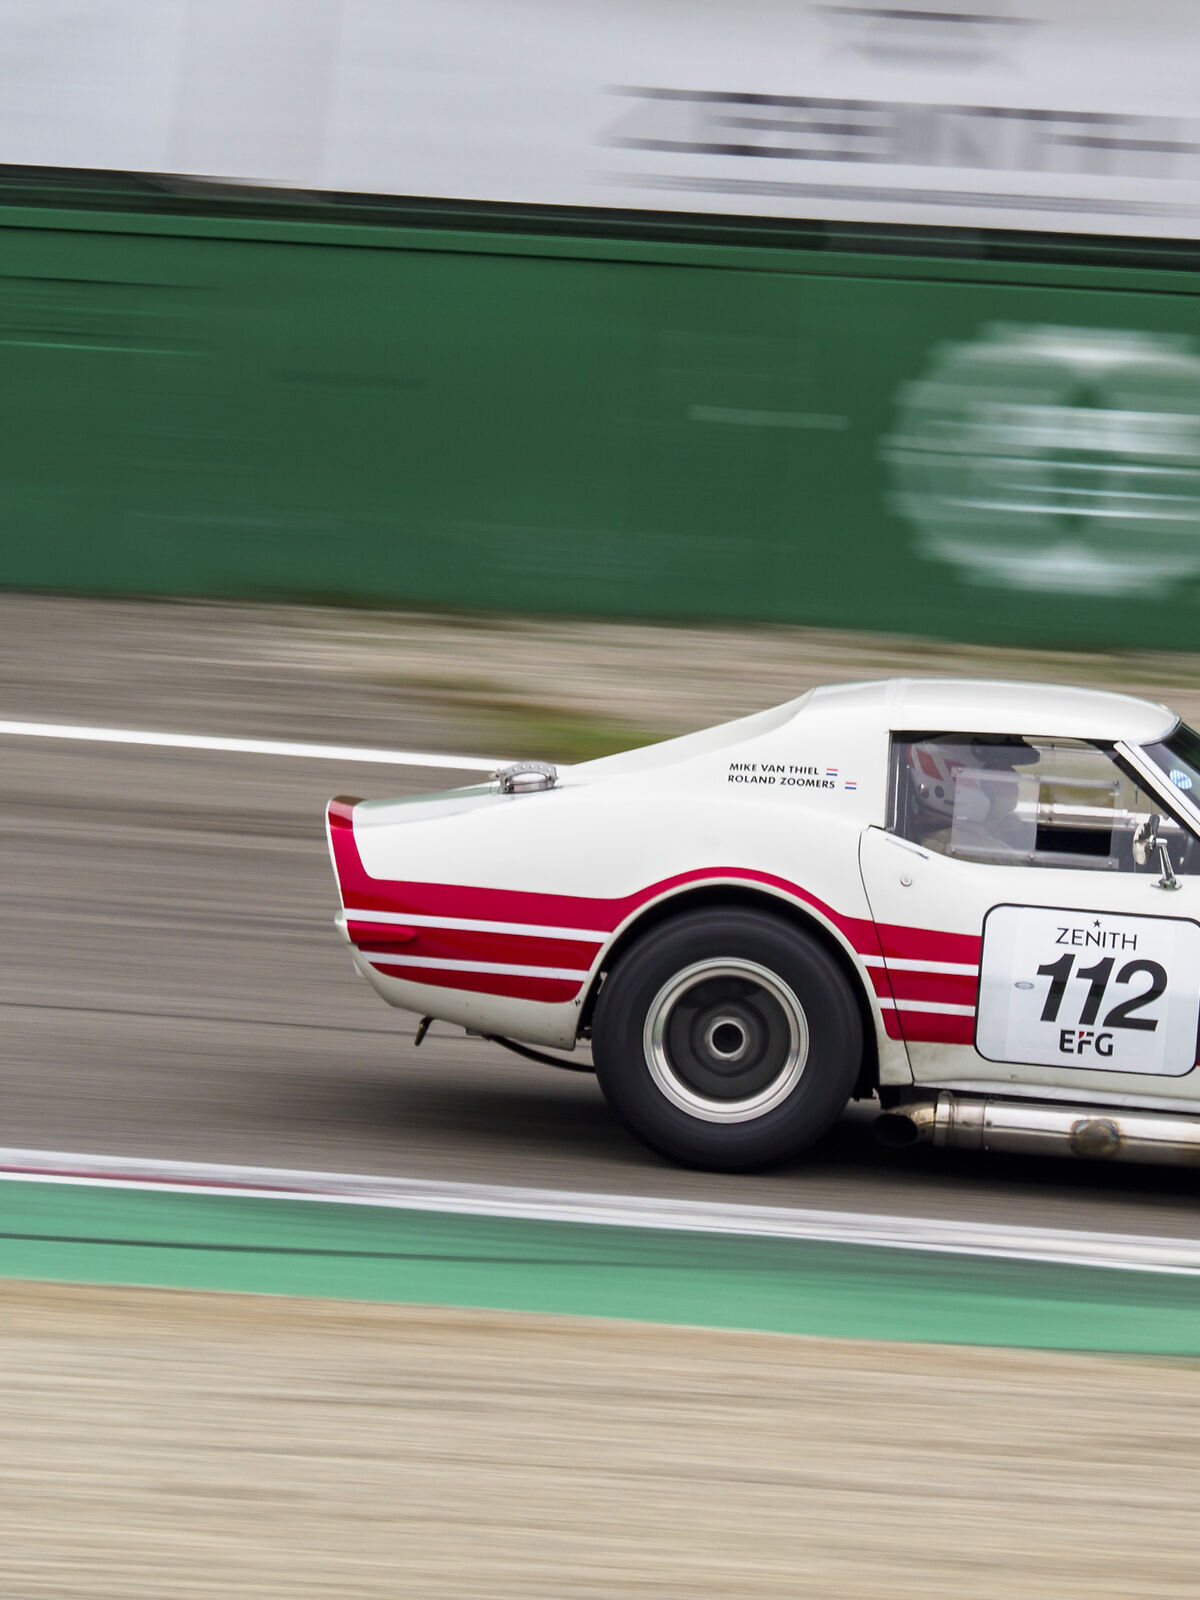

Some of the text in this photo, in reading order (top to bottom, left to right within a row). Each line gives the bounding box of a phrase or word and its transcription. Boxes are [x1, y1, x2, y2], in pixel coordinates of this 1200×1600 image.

[729, 763, 819, 775] MIKE VAN THIEL
[728, 775, 835, 788] ROLAND ZOOMERS
[1055, 927, 1137, 950] ZENITH
[1036, 953, 1168, 1031] 112
[1059, 1029, 1114, 1057] EFG
